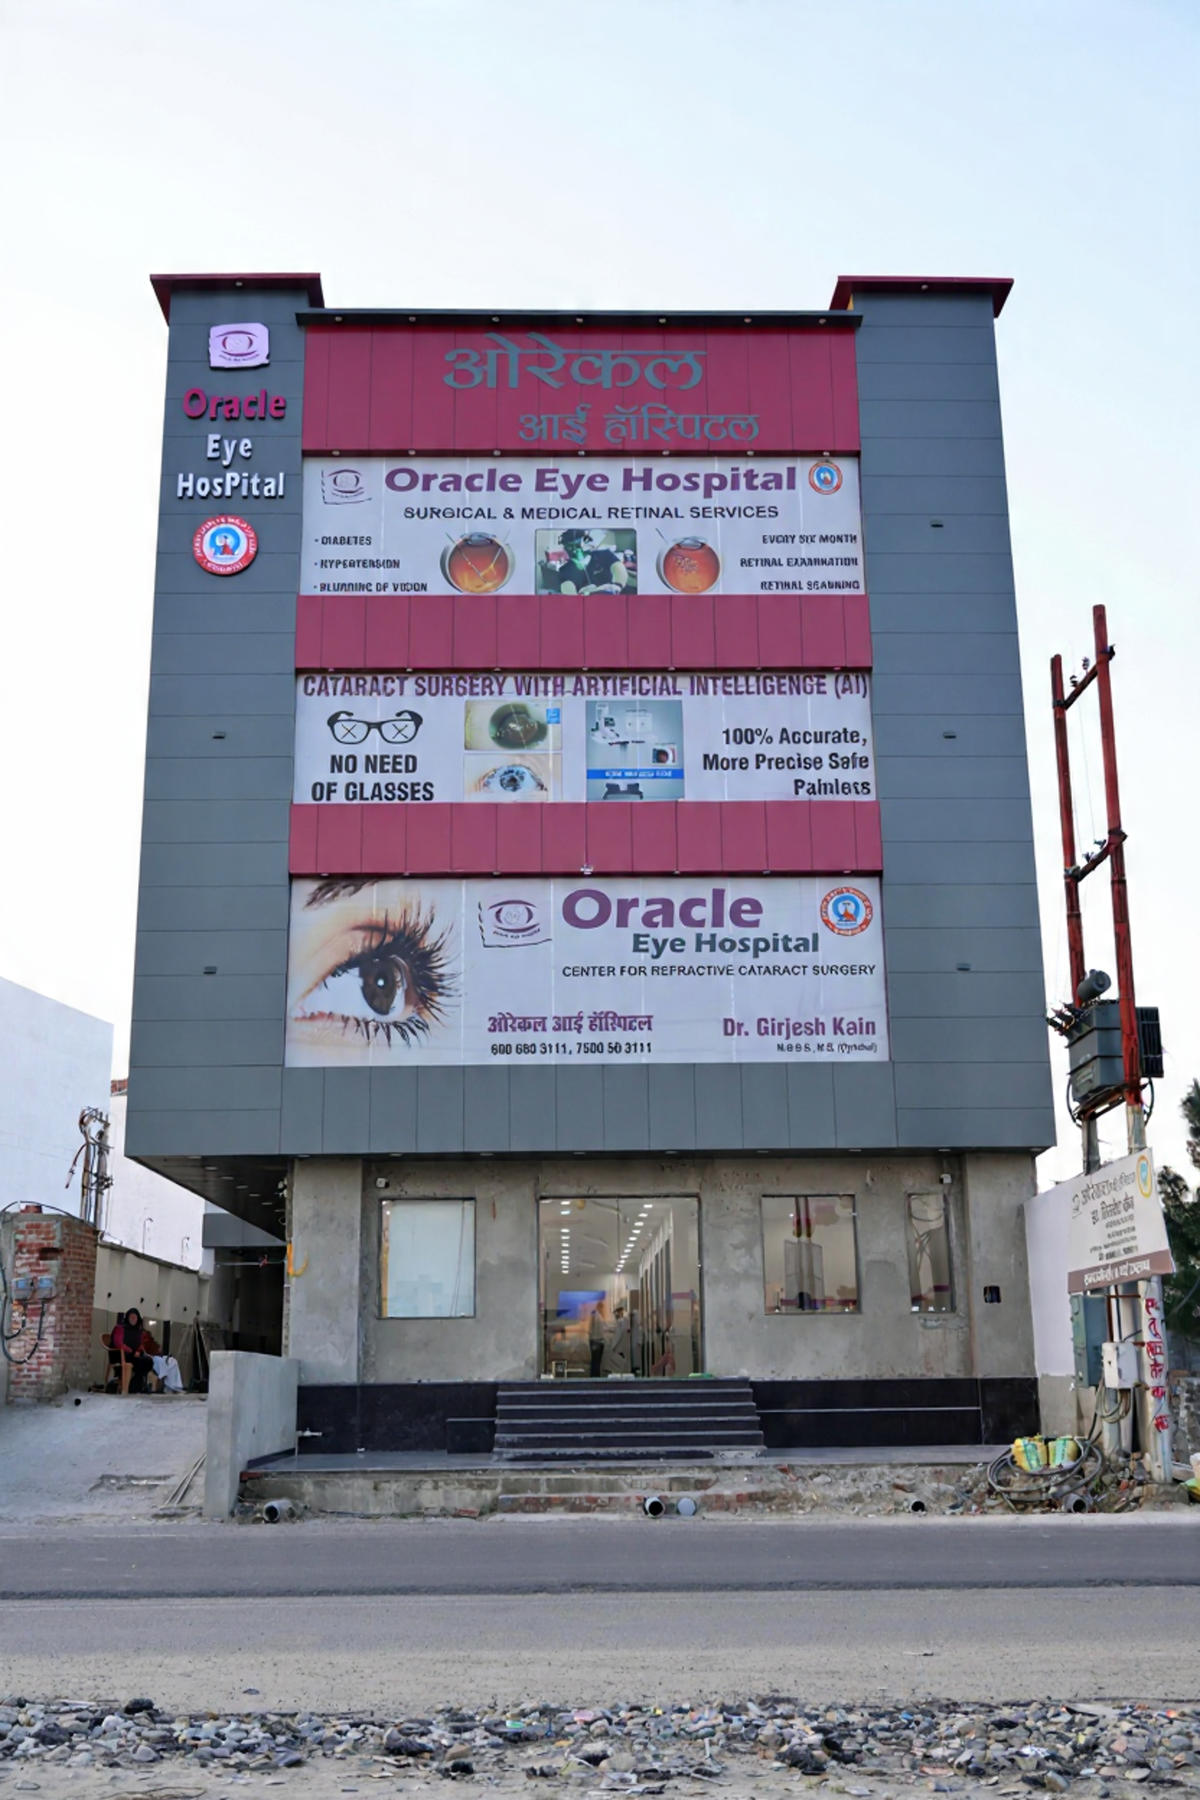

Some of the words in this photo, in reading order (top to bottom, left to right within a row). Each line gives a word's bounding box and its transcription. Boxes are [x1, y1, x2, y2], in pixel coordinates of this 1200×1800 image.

[443, 332, 707, 390] ओरेकल
[182, 388, 287, 421] Oracle
[519, 402, 592, 444] आई
[604, 402, 760, 443] हॉस्पिटल
[207, 434, 253, 467] Eye
[385, 467, 522, 493] Oracle
[534, 468, 610, 500] Eye
[622, 467, 796, 500] Hospital
[404, 507, 497, 519] SURGICAL
[503, 507, 515, 519] &
[521, 507, 602, 519] MEDICAL
[608, 507, 684, 519] RETINAL
[690, 506, 779, 519] SERVICES
[321, 536, 373, 546] DIABETES
[819, 534, 857, 543] MONTH
[740, 558, 783, 567] RETINAL
[303, 676, 408, 696] CATARACT
[414, 675, 508, 695] SURGERY
[514, 675, 565, 695] WITH
[572, 675, 682, 695] ARTIFICIAL
[834, 674, 867, 698] (AI)
[722, 728, 773, 744] 100%
[779, 728, 867, 745] Accurate,
[330, 755, 357, 773] NO
[364, 755, 417, 773] NEED
[703, 753, 748, 770] More
[755, 753, 822, 770] Precise
[829, 753, 869, 768] Safe
[311, 782, 337, 801] OF
[344, 782, 434, 801] GLASSES
[562, 887, 763, 929] Oracle
[632, 934, 686, 959] Eye
[695, 933, 819, 959] Hospital
[562, 966, 616, 977] CENTER
[620, 966, 647, 976] FOR
[651, 965, 734, 976] REFRACTIVE
[738, 965, 808, 976] CATARACT
[812, 964, 876, 975] SURGERY
[488, 1011, 548, 1032] ओरेकल
[552, 1011, 583, 1034] आई
[588, 1010, 653, 1032] हॉस्पिटल
[723, 1018, 749, 1036] Dr.
[757, 1017, 826, 1040] Girjesh
[833, 1017, 876, 1035] Kain
